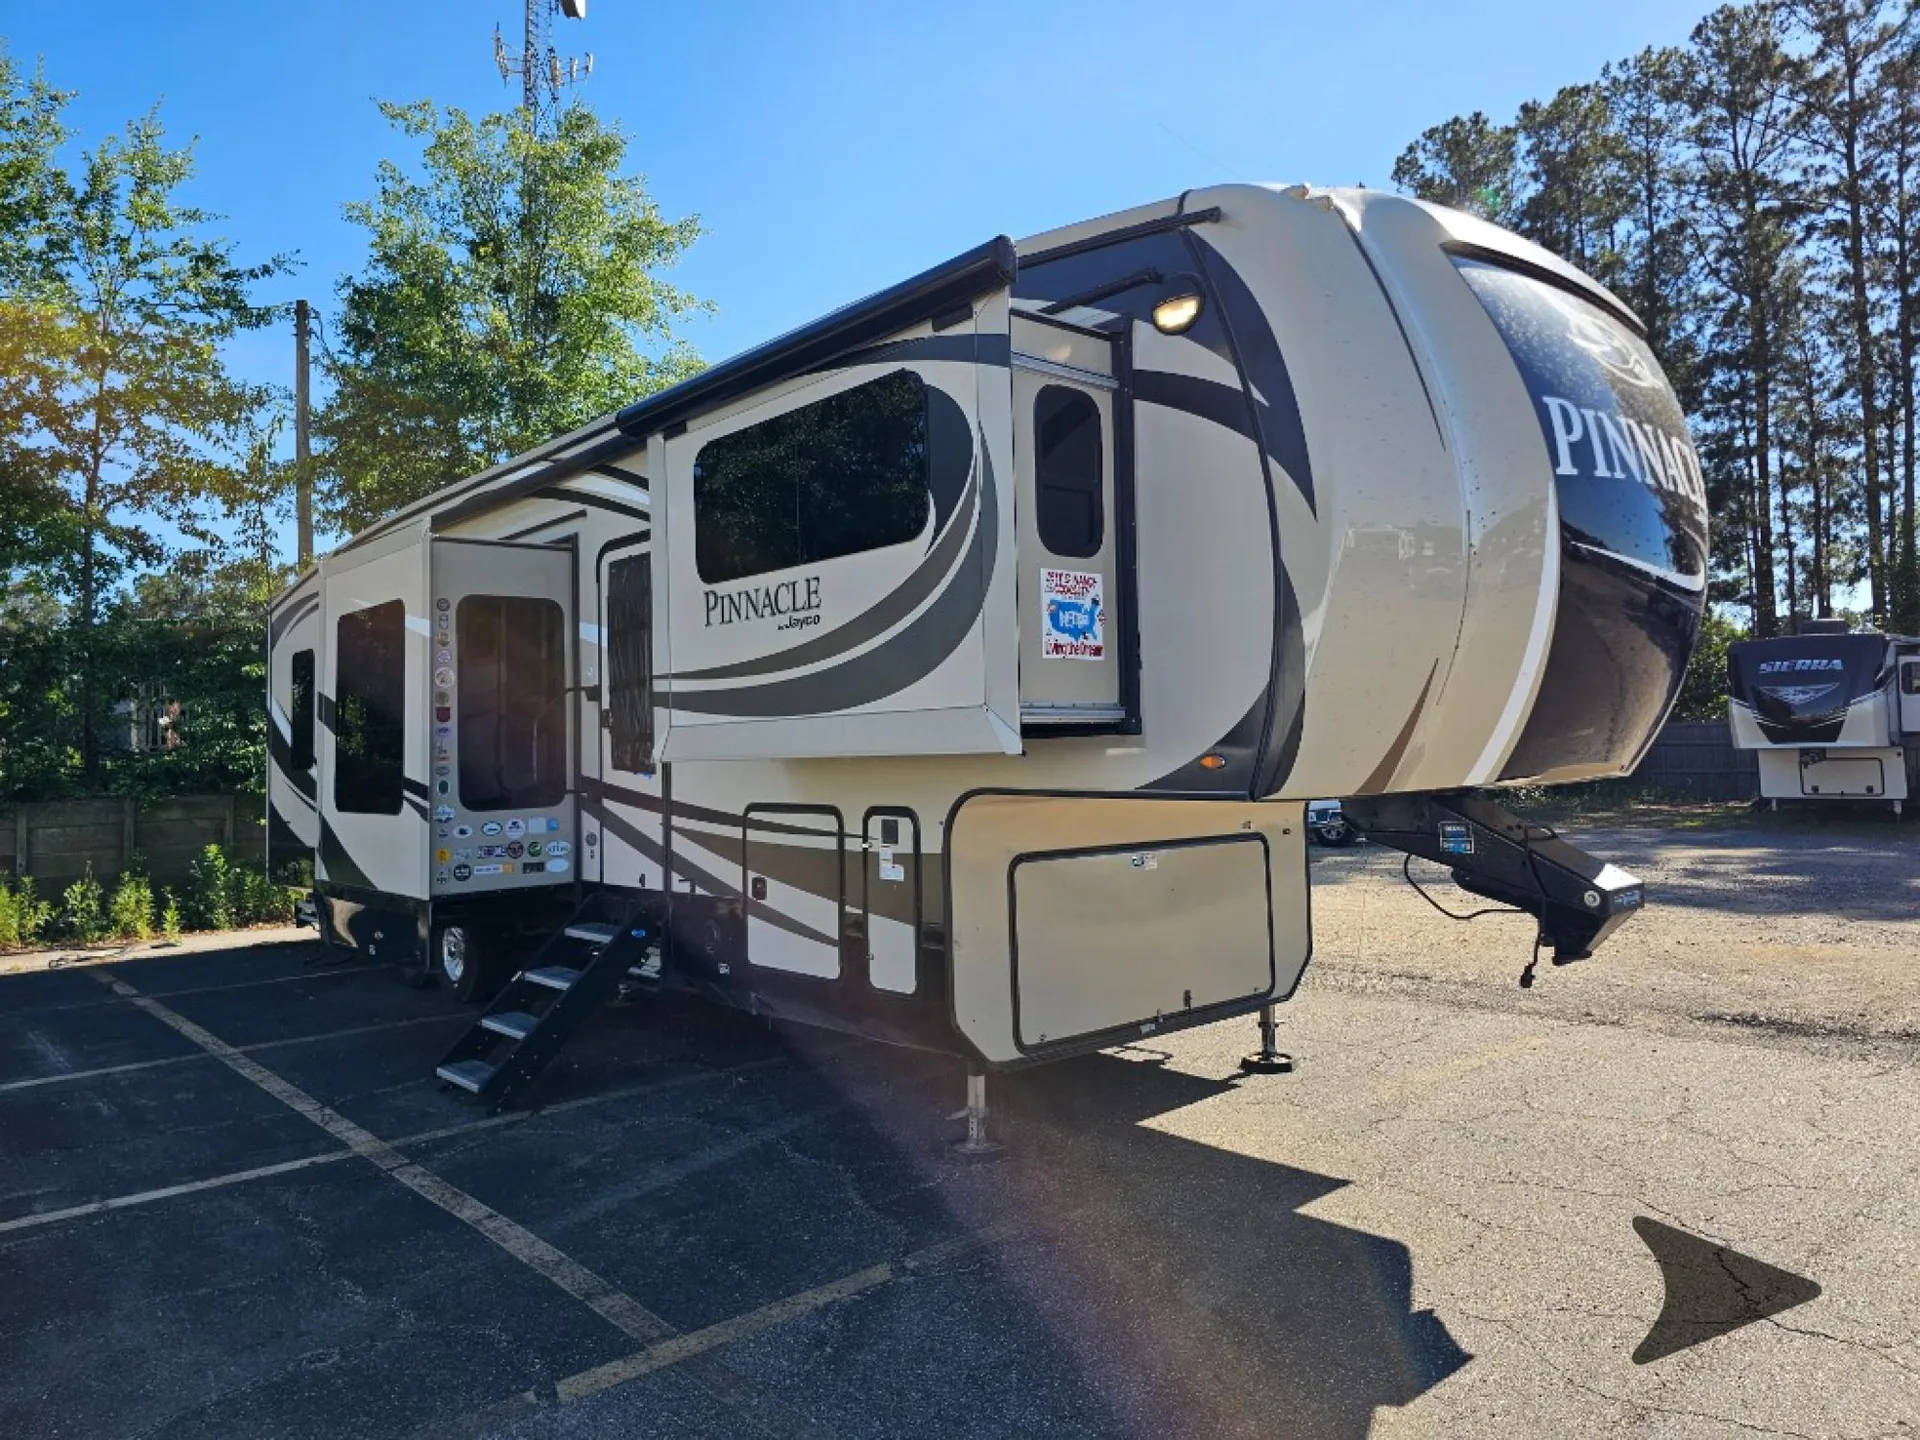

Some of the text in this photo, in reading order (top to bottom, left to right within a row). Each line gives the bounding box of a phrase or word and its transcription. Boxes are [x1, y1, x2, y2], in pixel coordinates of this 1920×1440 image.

[703, 575, 822, 627] PINNACLE
[788, 614, 821, 631] Jayco
[1758, 659, 1844, 674] SIERRA
